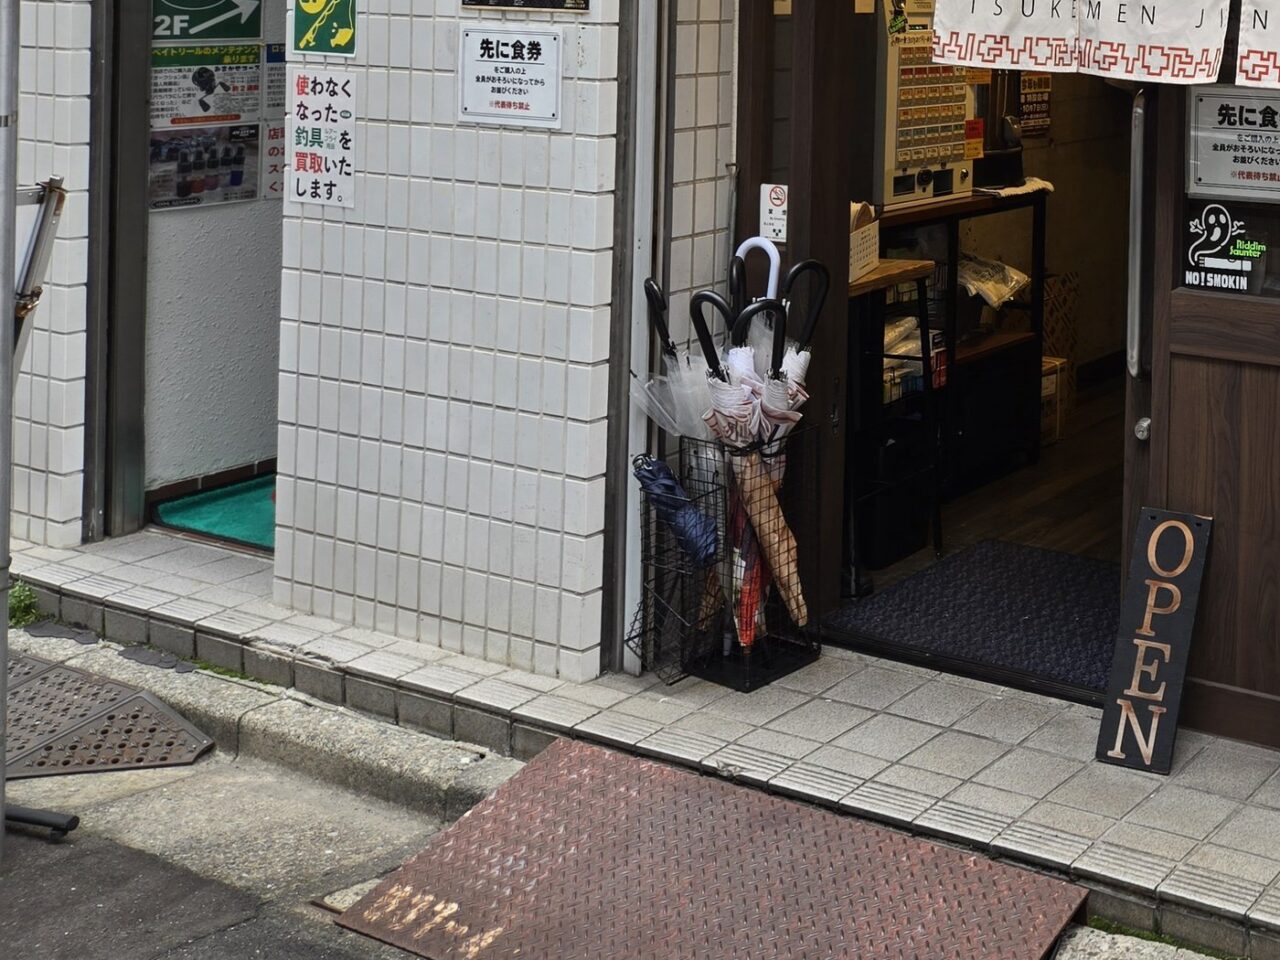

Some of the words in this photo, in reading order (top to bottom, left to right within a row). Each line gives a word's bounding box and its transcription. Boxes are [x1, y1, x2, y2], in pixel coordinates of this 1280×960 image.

[154, 14, 190, 36] 2F
[479, 38, 542, 61] 先に食券
[296, 75, 352, 98] 使わなく
[296, 101, 338, 123] なった
[295, 126, 324, 148] 釣具
[295, 152, 352, 177] 買取いた
[296, 178, 343, 202] します。
[1229, 246, 1262, 258] Saunter
[1236, 239, 1266, 252] Riddim
